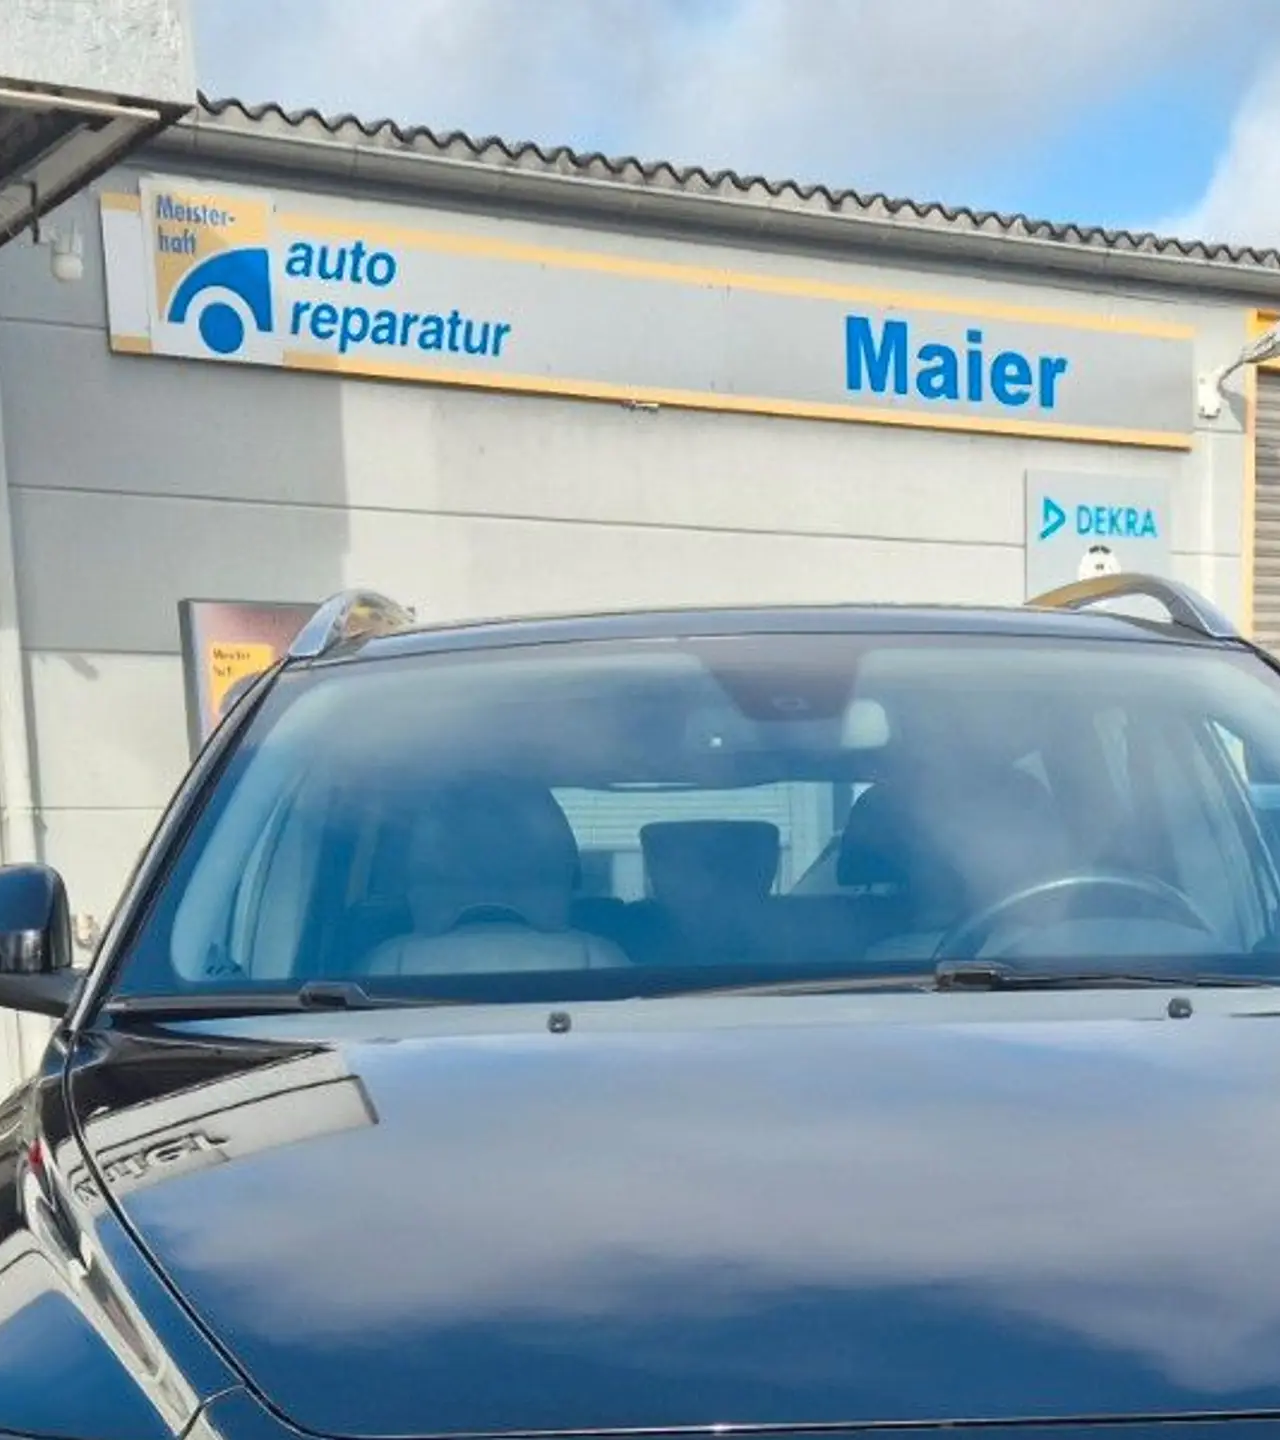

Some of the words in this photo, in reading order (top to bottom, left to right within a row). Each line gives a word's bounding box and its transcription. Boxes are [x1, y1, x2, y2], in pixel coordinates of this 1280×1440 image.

[156, 194, 236, 226] Meister-
[157, 224, 196, 253] haft
[285, 240, 397, 287] auto
[290, 300, 511, 358] reparatur
[845, 315, 1069, 409] Maier
[1076, 504, 1158, 538] DEKRA
